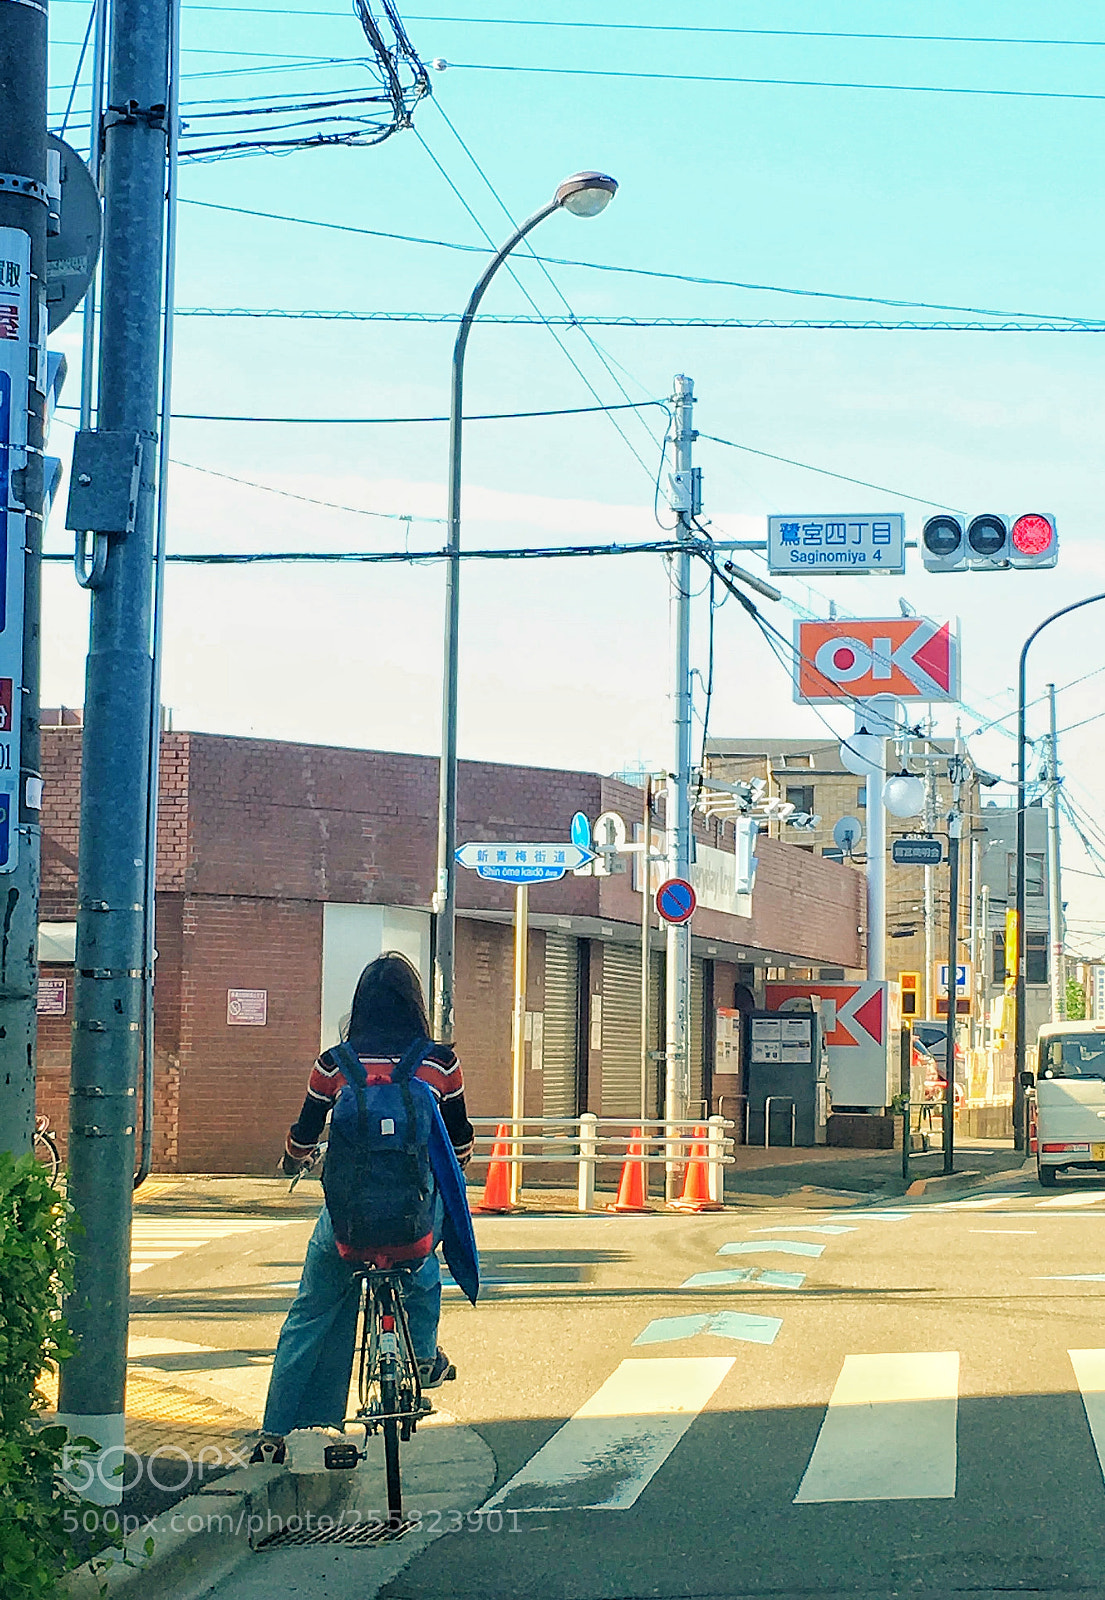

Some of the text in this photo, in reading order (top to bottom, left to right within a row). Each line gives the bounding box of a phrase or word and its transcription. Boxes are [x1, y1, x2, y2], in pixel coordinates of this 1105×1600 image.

[779, 522, 892, 546] 鷺宮四丁目
[790, 550, 882, 564] Saginomiya 4
[815, 620, 949, 696] OK
[476, 849, 566, 864] 新青梅街道
[482, 866, 500, 876] Shin
